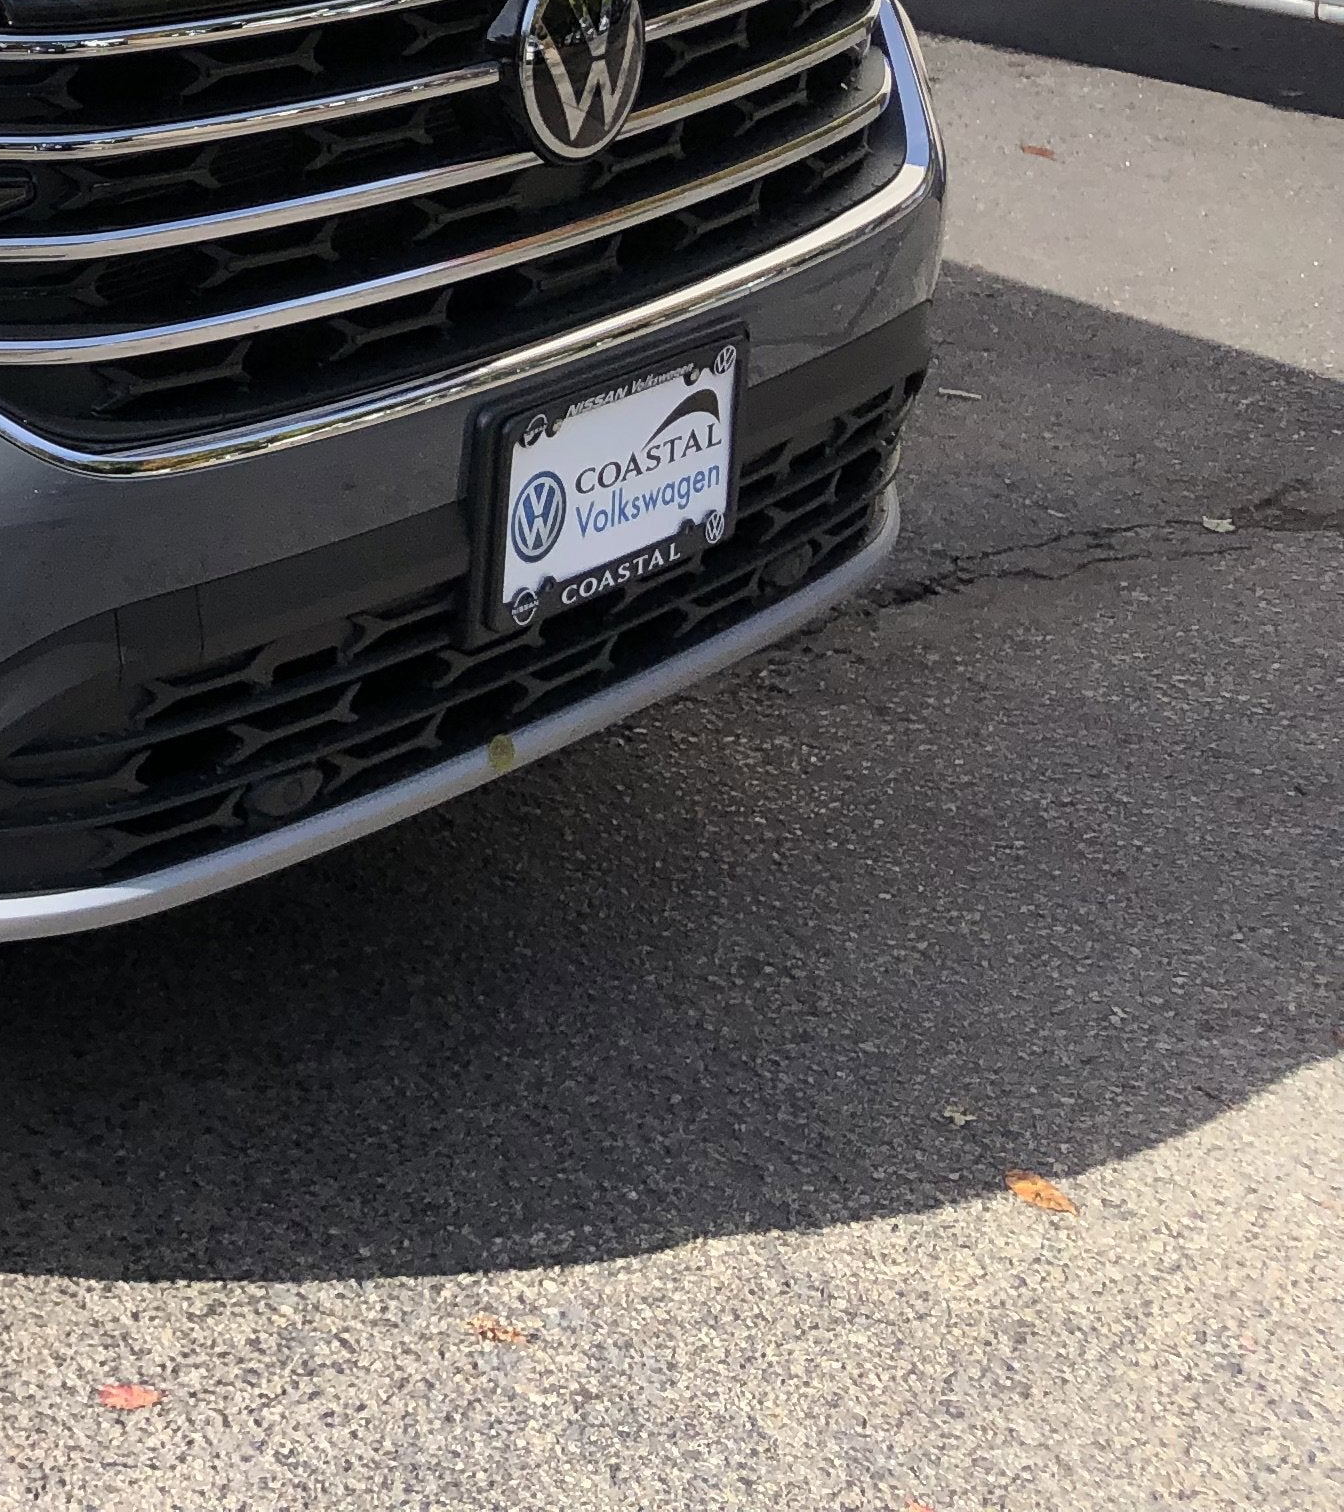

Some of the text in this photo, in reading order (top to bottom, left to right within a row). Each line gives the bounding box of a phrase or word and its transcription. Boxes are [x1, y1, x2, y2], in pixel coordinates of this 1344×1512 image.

[566, 384, 628, 418] NISSAN
[574, 422, 723, 495] COASTAL
[514, 475, 565, 560] VW
[575, 464, 721, 539] Volkswagen
[561, 542, 681, 605] COASTAL
